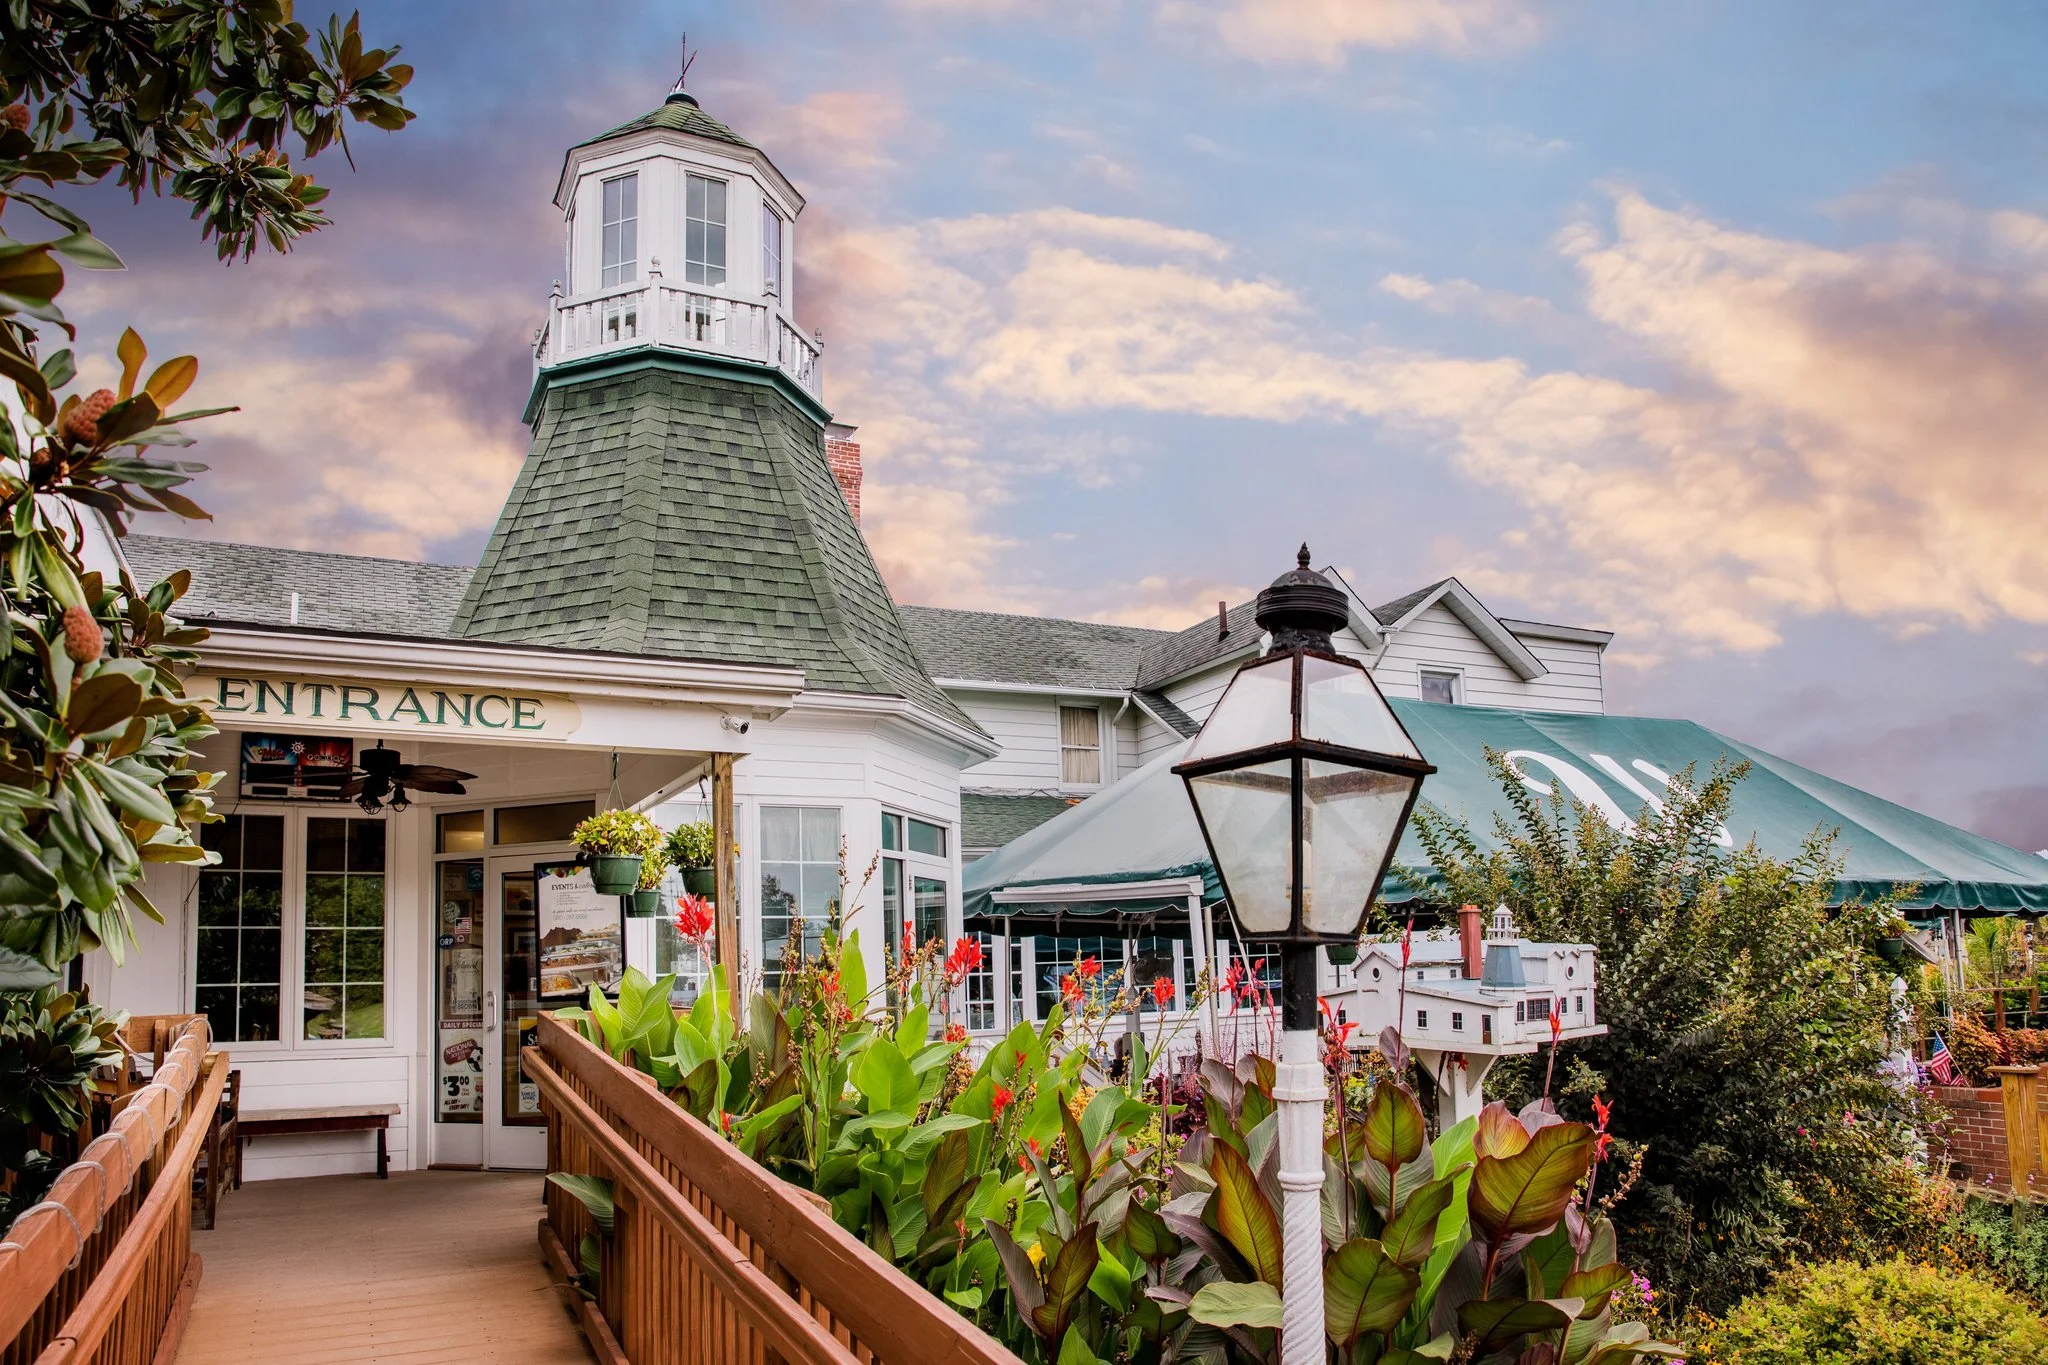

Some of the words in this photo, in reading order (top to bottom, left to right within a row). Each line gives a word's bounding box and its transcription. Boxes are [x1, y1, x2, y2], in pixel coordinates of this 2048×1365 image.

[211, 677, 547, 730] ENTRANCE
[552, 883, 574, 891] EVENTS
[446, 1040, 474, 1055] NATIONAL
